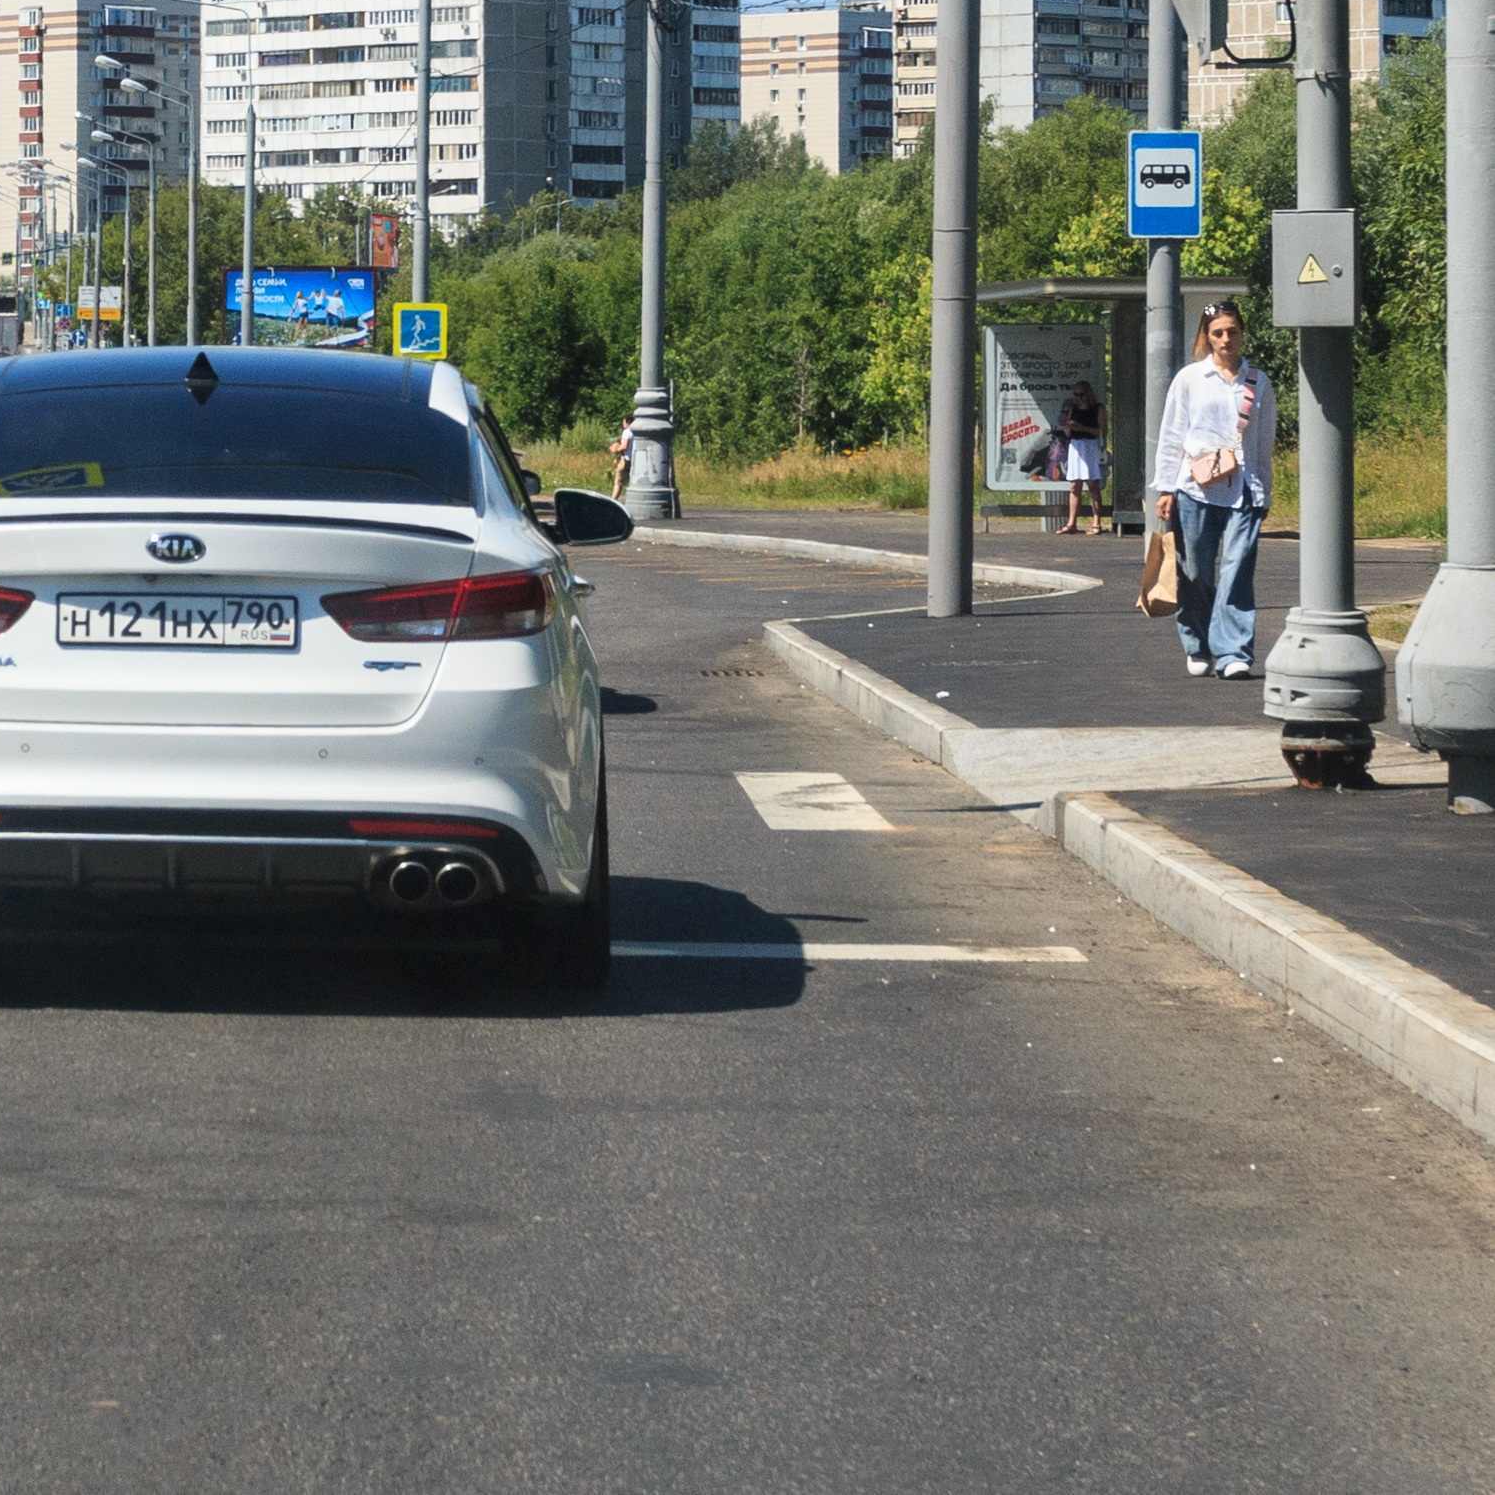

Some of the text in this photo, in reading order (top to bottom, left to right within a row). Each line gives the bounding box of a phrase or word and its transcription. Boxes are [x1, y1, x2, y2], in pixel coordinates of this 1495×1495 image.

[1000, 382, 1017, 392] Да
[1019, 380, 1057, 392] брось
[156, 539, 197, 557] KIA
[70, 601, 285, 639] Н121НХ 790
[240, 630, 269, 641] RUS
